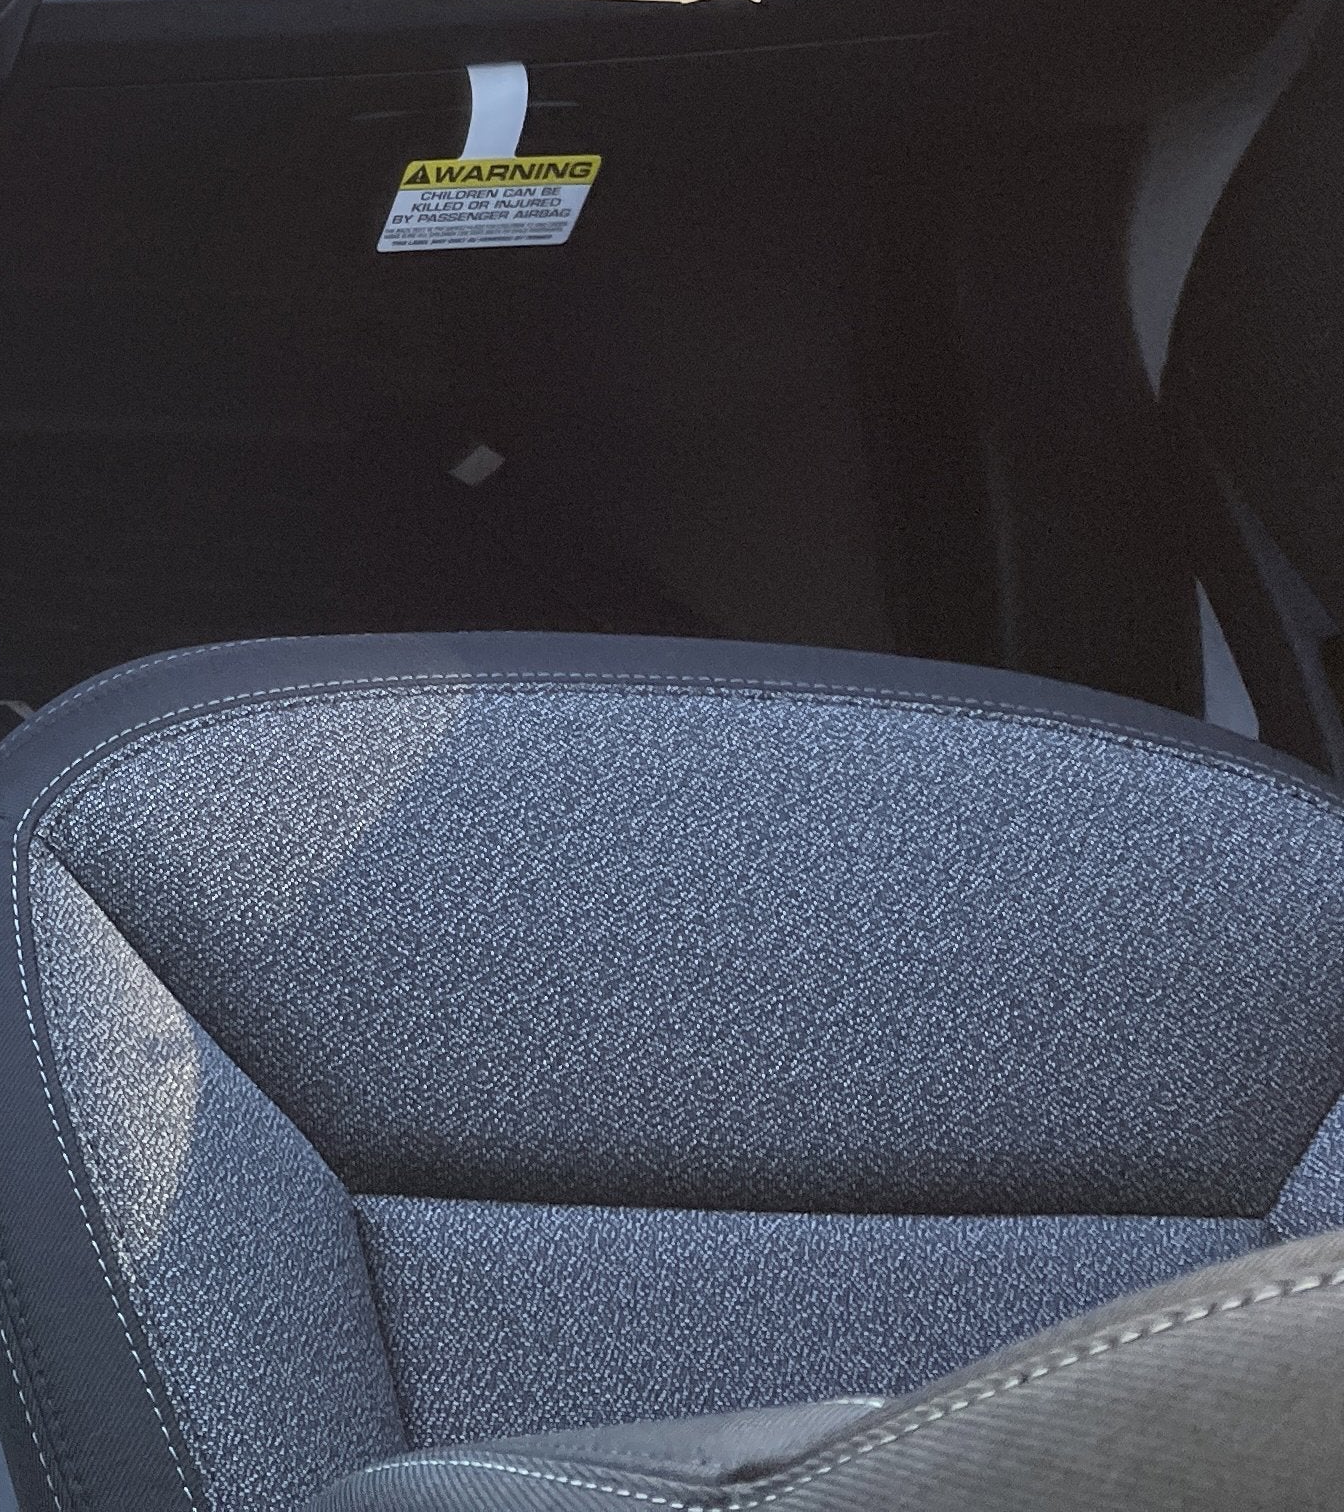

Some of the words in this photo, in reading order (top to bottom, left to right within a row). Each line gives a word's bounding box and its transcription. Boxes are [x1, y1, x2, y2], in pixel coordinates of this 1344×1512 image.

[434, 162, 593, 184] WARNING
[420, 189, 499, 201] CHILDREN
[502, 187, 537, 198] CAN
[540, 186, 562, 196] BE
[411, 201, 464, 213] KILLED
[467, 200, 489, 210] OR
[494, 198, 561, 209] INJURED
[392, 214, 414, 225] BY
[417, 211, 510, 223] PASSENGER
[513, 208, 572, 220] AIRBAG
